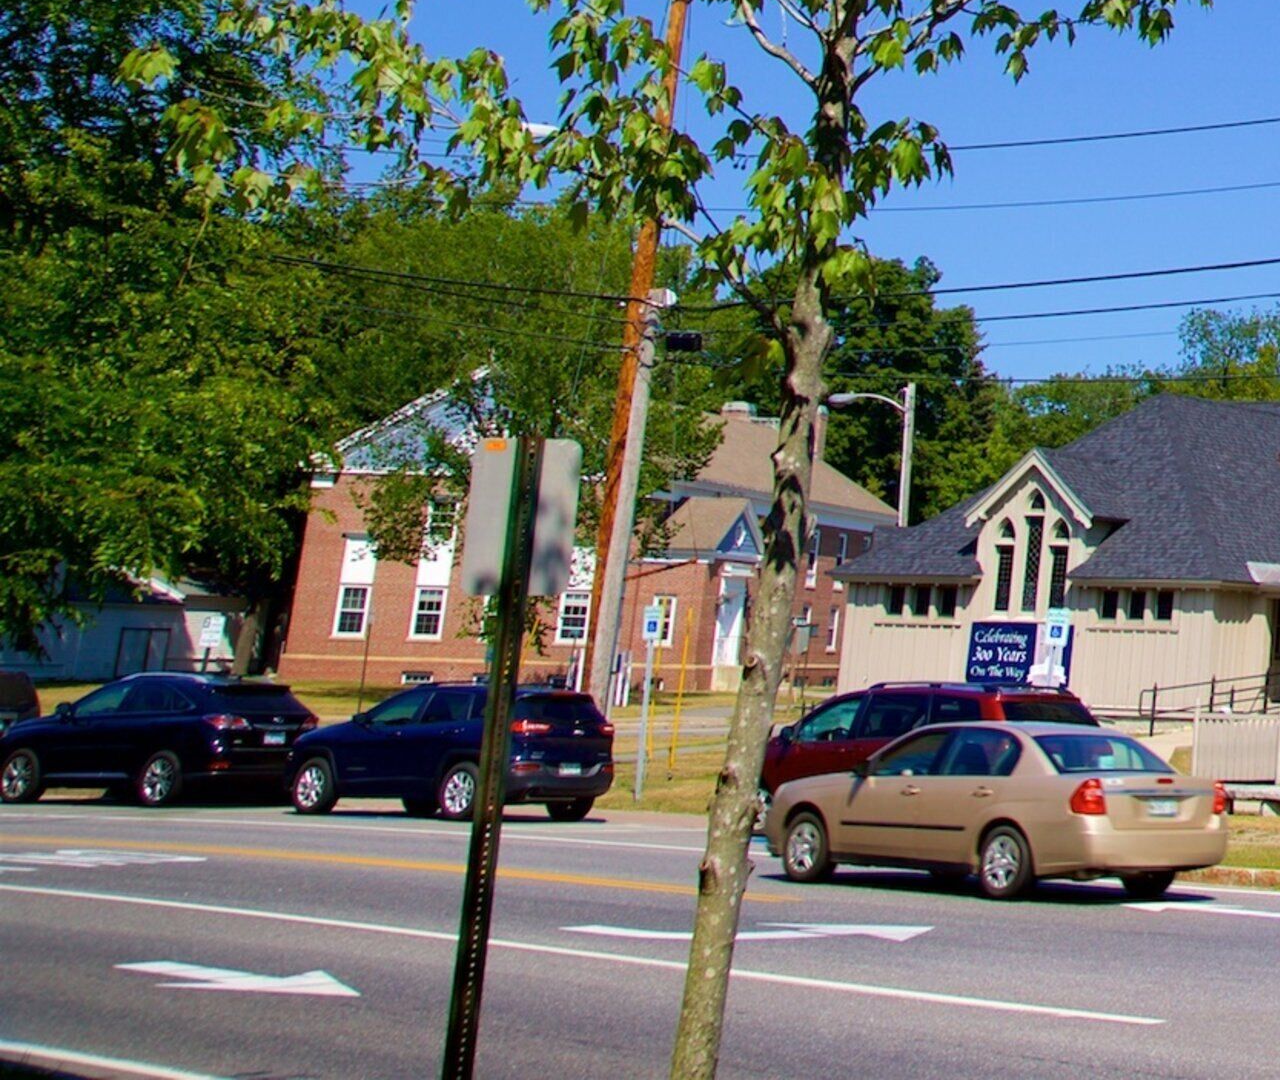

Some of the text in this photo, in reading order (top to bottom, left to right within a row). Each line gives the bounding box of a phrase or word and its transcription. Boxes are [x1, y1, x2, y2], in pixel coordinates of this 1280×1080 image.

[974, 627, 1029, 649] Celebrating
[972, 646, 1027, 663] 300 Years
[970, 665, 986, 676] On
[1005, 666, 1026, 681] Way
